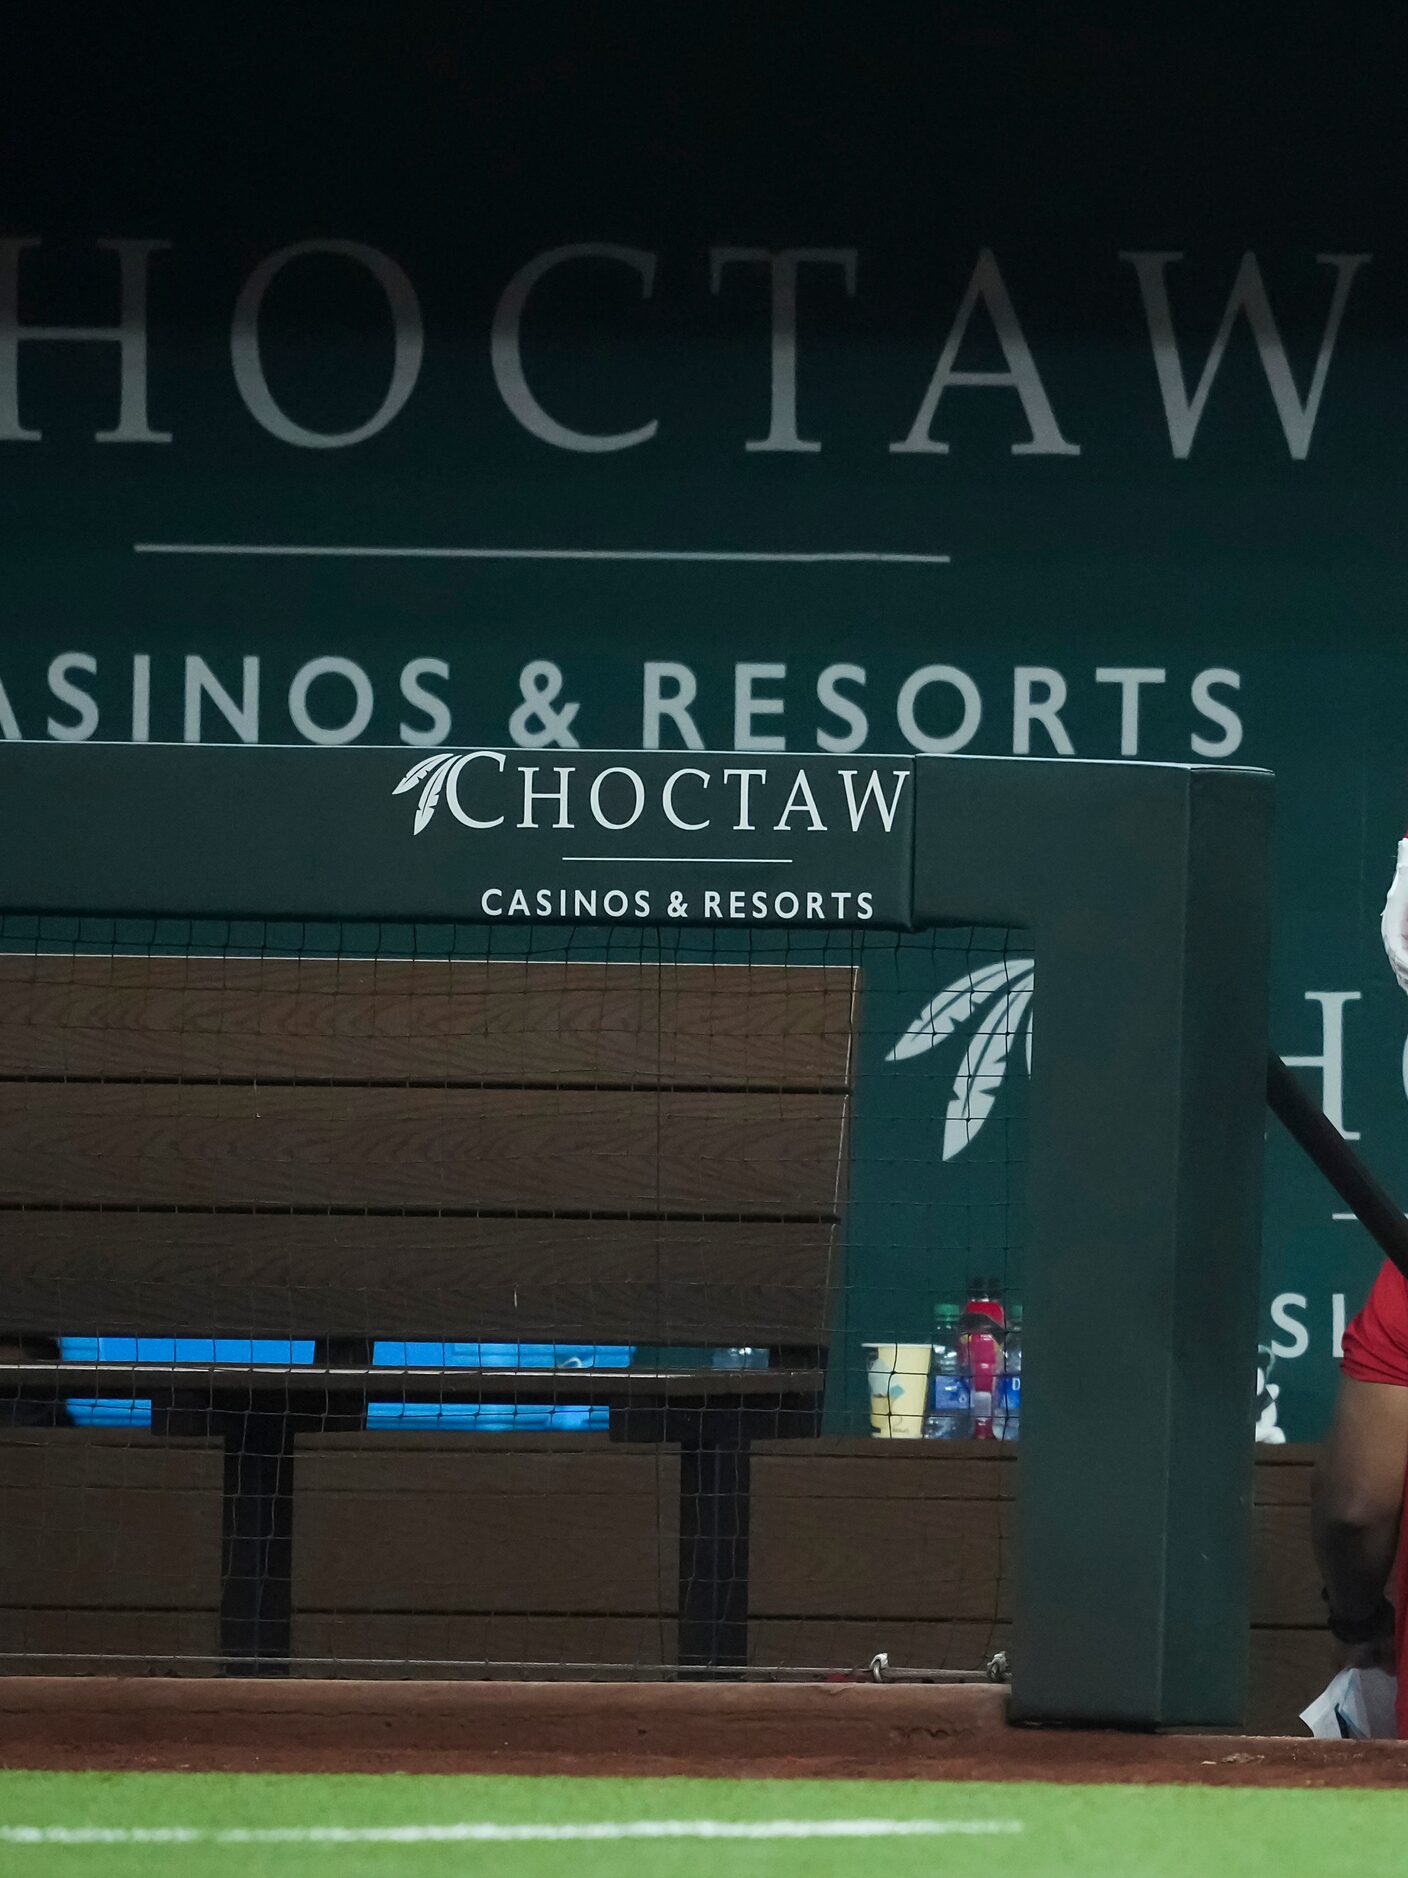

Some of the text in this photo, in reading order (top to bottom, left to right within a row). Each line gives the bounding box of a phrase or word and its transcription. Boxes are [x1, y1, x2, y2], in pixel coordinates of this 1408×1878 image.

[0, 652, 1244, 758] SINOS & RESORTS
[446, 750, 910, 833] CHOCTAW
[481, 888, 873, 920] CASINOS & RESORTS
